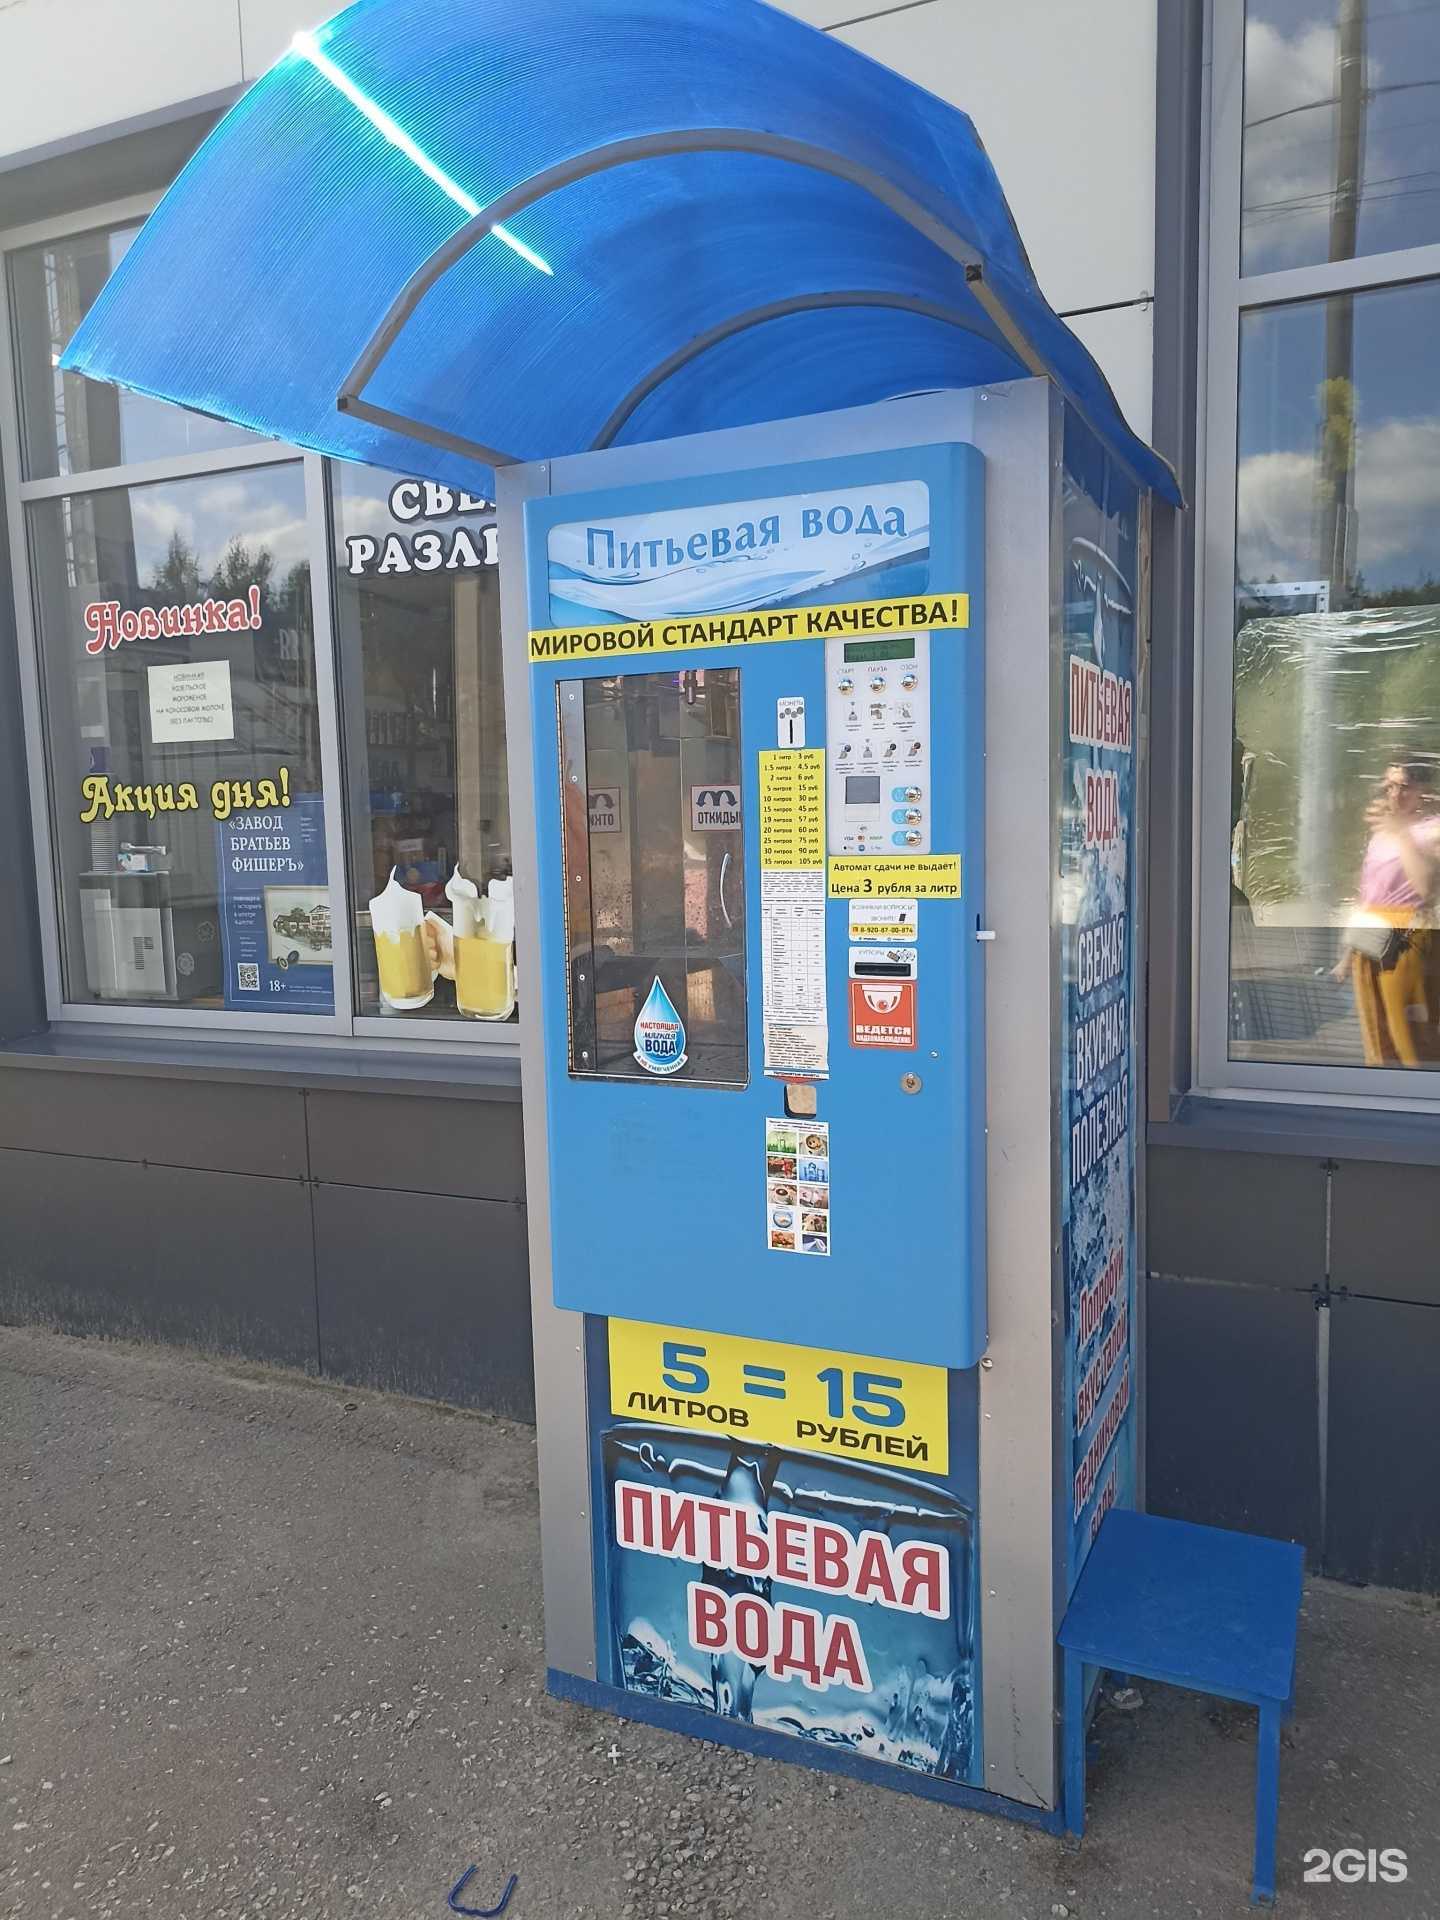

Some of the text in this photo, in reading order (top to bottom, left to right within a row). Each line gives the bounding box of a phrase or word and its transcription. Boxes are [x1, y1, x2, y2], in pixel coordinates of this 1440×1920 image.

[586, 503, 907, 570] Питьевая вода
[85, 585, 261, 654] Новинка!
[531, 599, 959, 657] МИРОВОЙ СТАНДАРТ КАЧЕСТВА!
[1071, 662, 1131, 746] ПИТЬЕВАЯ
[80, 767, 292, 823] Акция дня!
[228, 815, 283, 831] «ЗАВОД
[698, 811, 741, 826] ОТКИДЫ
[1087, 774, 1118, 850] ВОДА
[230, 836, 291, 851] БРАТЬЕВ
[231, 857, 304, 873] ФИШЕРЪ»
[834, 863, 871, 872] Автомат
[874, 864, 901, 872] сдачи
[917, 862, 956, 872] выдает!
[831, 879, 957, 895] Цена 3 рубля за литр
[269, 980, 286, 992] 18+
[1078, 920, 1124, 995] СВЕЖАЯ
[640, 1022, 679, 1031] НАСТОЯЩАЯ
[645, 1040, 676, 1054] ВОДА
[856, 1024, 912, 1035] ВЕДЕТСЯ
[1076, 998, 1126, 1090] ВКУСНАЯ
[1072, 1074, 1128, 1189] ПОЛЕЗНАЯ
[1081, 1238, 1124, 1345] Попробуй
[661, 1341, 710, 1394] 5
[816, 1367, 906, 1428] 15
[627, 1391, 928, 1462] ЛИТРОВ РУБЛЕЙ
[621, 1486, 941, 1612] ПИТЬЕВАЯ
[694, 1588, 864, 1686] ВОДА
